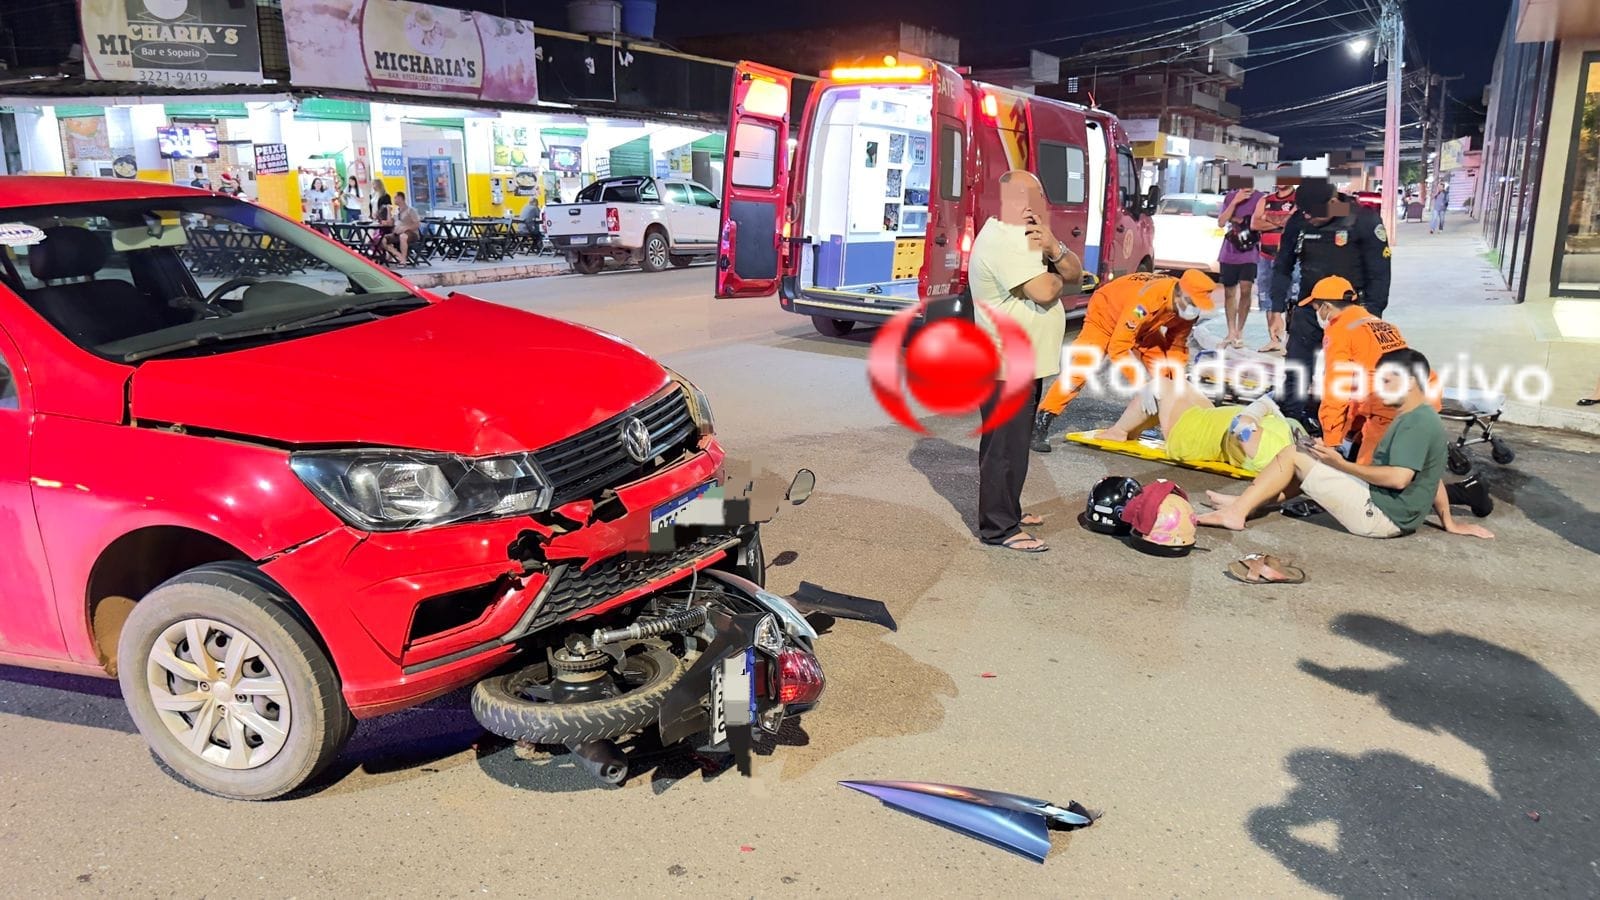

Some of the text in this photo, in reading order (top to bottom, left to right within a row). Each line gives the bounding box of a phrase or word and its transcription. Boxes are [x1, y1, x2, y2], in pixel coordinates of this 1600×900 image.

[141, 47, 157, 57] Bar
[167, 48, 200, 58] Soparia
[374, 50, 476, 79] MICHARIA'S
[139, 70, 208, 82] 3221-9419
[255, 144, 286, 156] PEIXE
[256, 152, 287, 163] ASSADO
[383, 158, 401, 167] COCO
